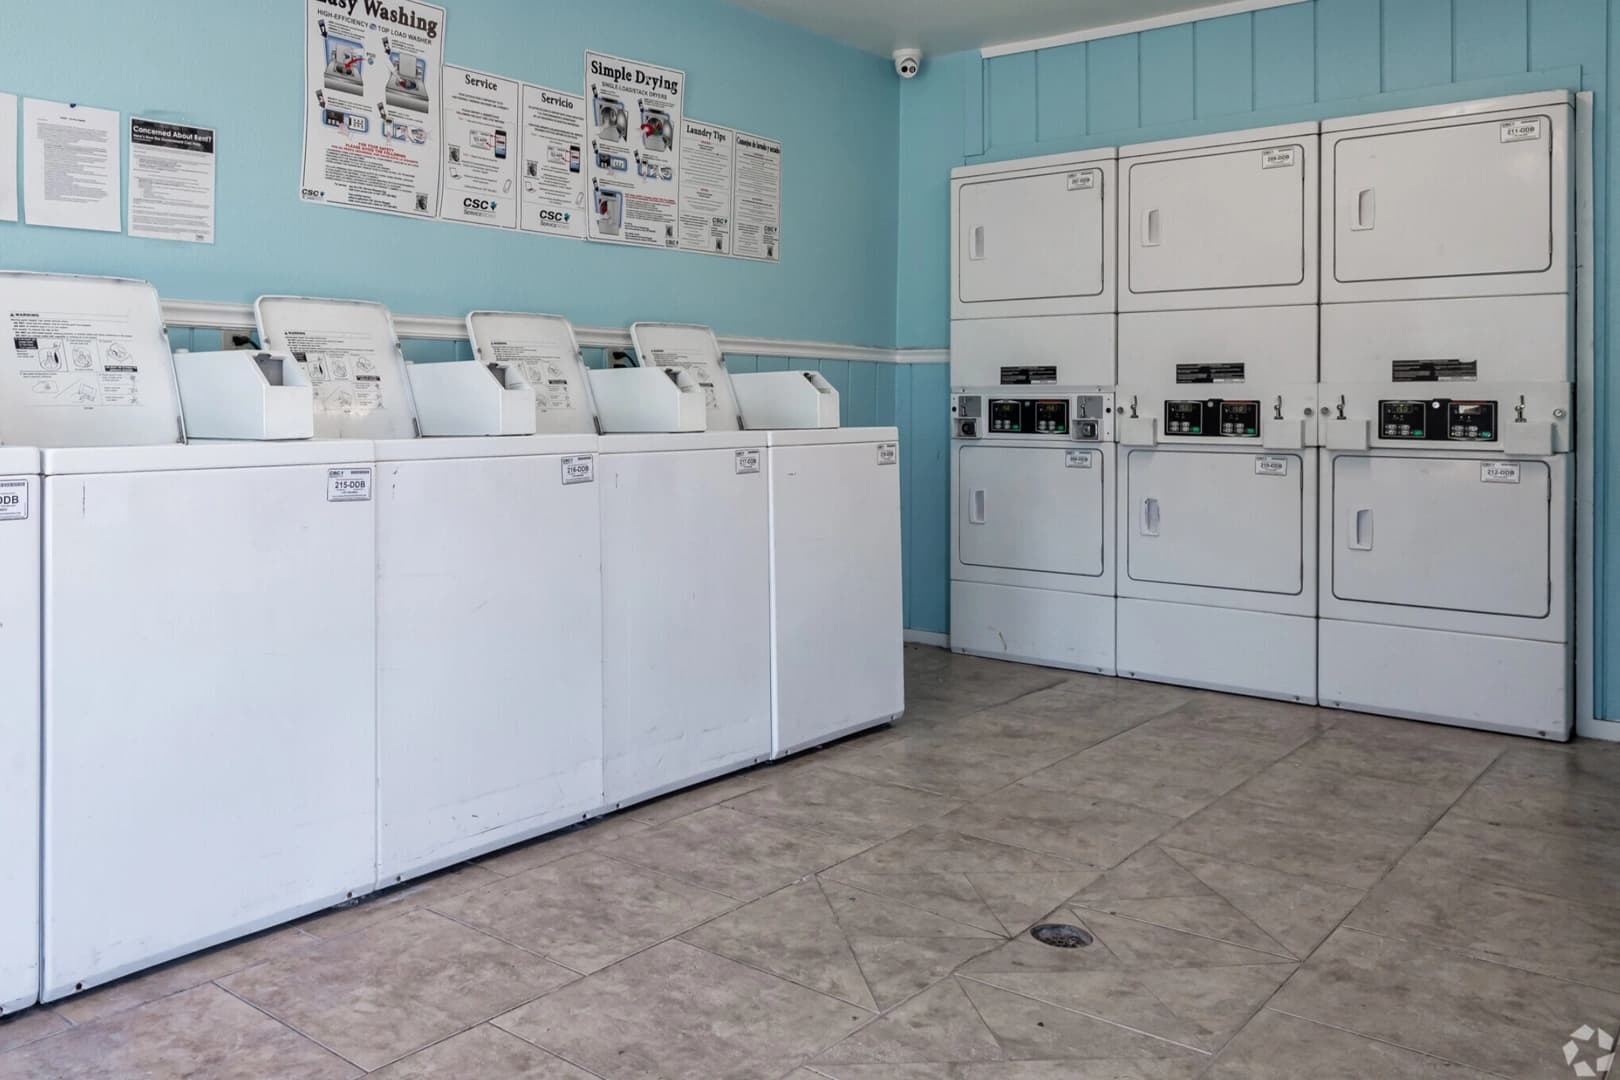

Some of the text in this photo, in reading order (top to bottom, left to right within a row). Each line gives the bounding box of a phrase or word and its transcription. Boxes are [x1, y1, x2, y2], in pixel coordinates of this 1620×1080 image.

[314, 0, 359, 16] asy
[364, 0, 438, 38] Washing
[317, 8, 368, 29] HIGH-EFFICIENCY
[391, 28, 407, 39] LOAD
[465, 74, 498, 91] Service
[591, 60, 678, 95] Simple Drying
[541, 92, 574, 109] Servicio
[133, 125, 172, 137] Concerned
[172, 131, 193, 140] About
[686, 124, 726, 142] Laundry Tips
[302, 188, 319, 197] CSC
[463, 197, 489, 210] CSC
[539, 210, 562, 222] CSC
[0, 495, 19, 505] DB
